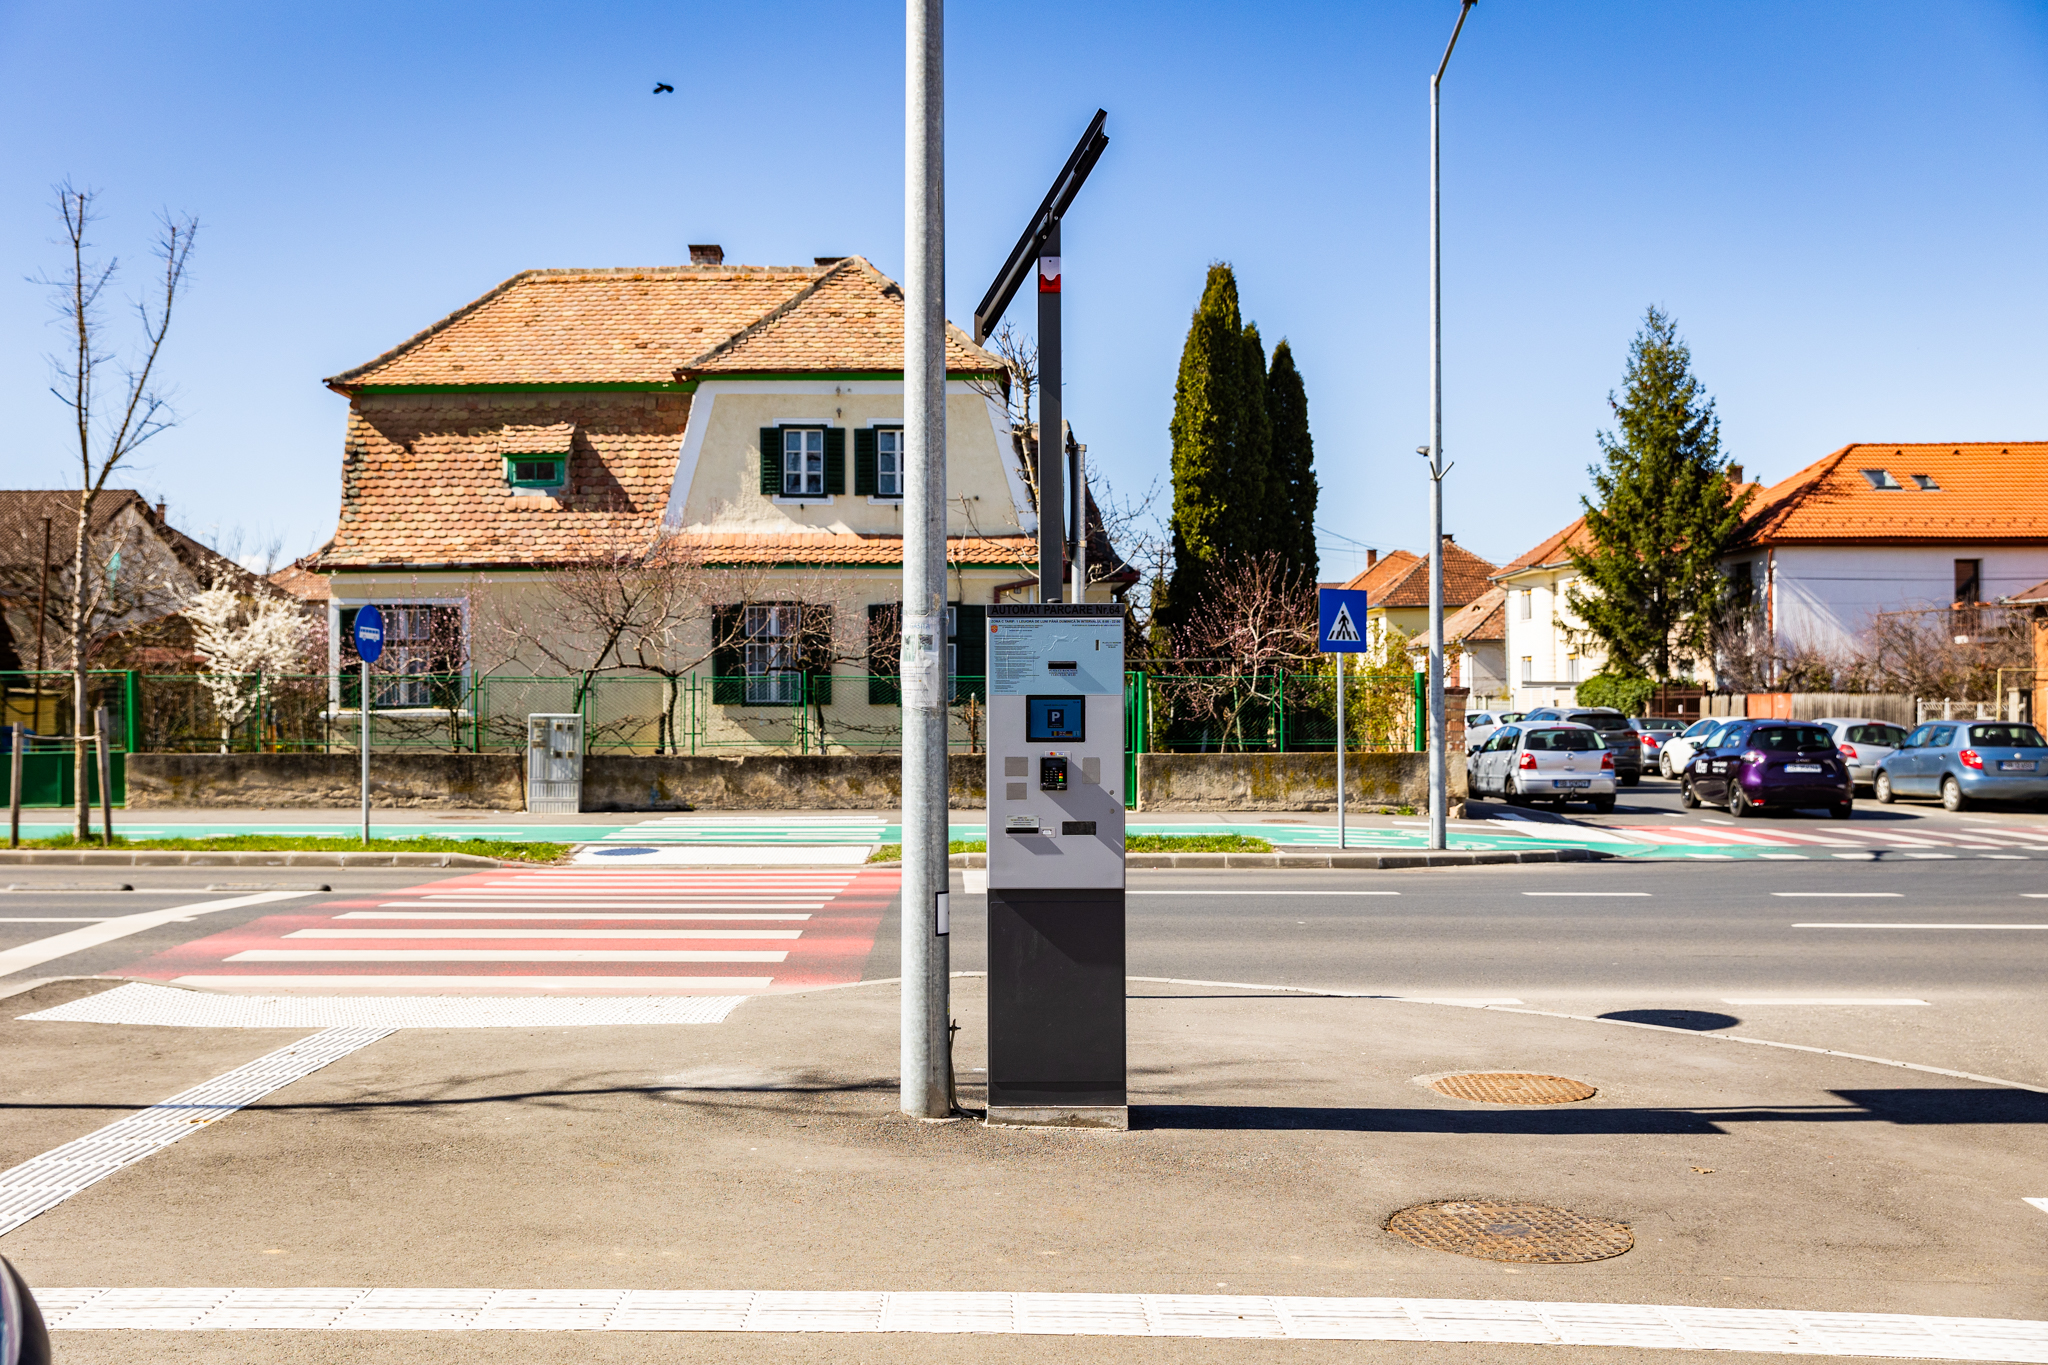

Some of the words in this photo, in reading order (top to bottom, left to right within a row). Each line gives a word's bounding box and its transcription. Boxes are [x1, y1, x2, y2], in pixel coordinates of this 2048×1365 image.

[991, 605, 1041, 614] AUTOMAT
[1043, 605, 1093, 614] PARCARE
[1095, 605, 1121, 614] Nr.64
[1051, 711, 1061, 722] P
[1695, 759, 1708, 774] Uber
